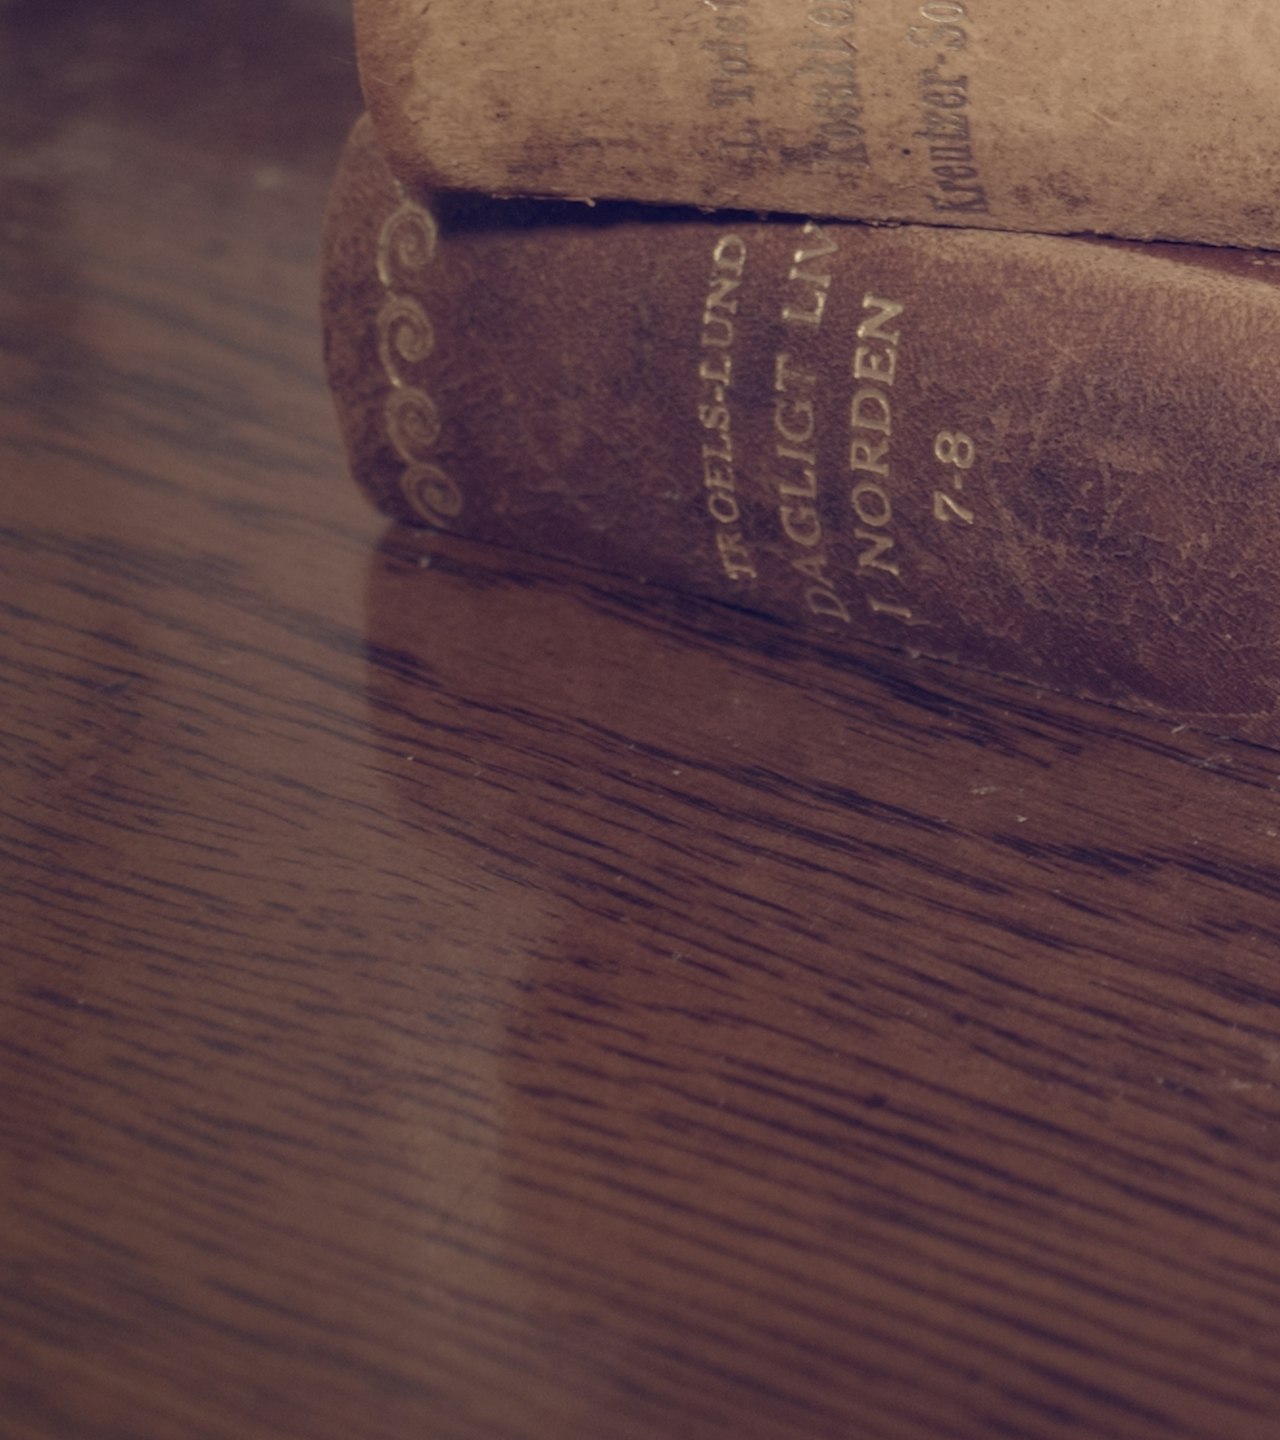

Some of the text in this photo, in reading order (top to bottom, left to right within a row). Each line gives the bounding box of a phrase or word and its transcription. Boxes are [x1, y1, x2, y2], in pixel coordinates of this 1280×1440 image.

[695, 231, 759, 582] TROELS-LUND
[773, 220, 852, 625] DAGLIGT LIV
[848, 289, 914, 621] I NORDEN
[931, 429, 976, 526] 7-8
